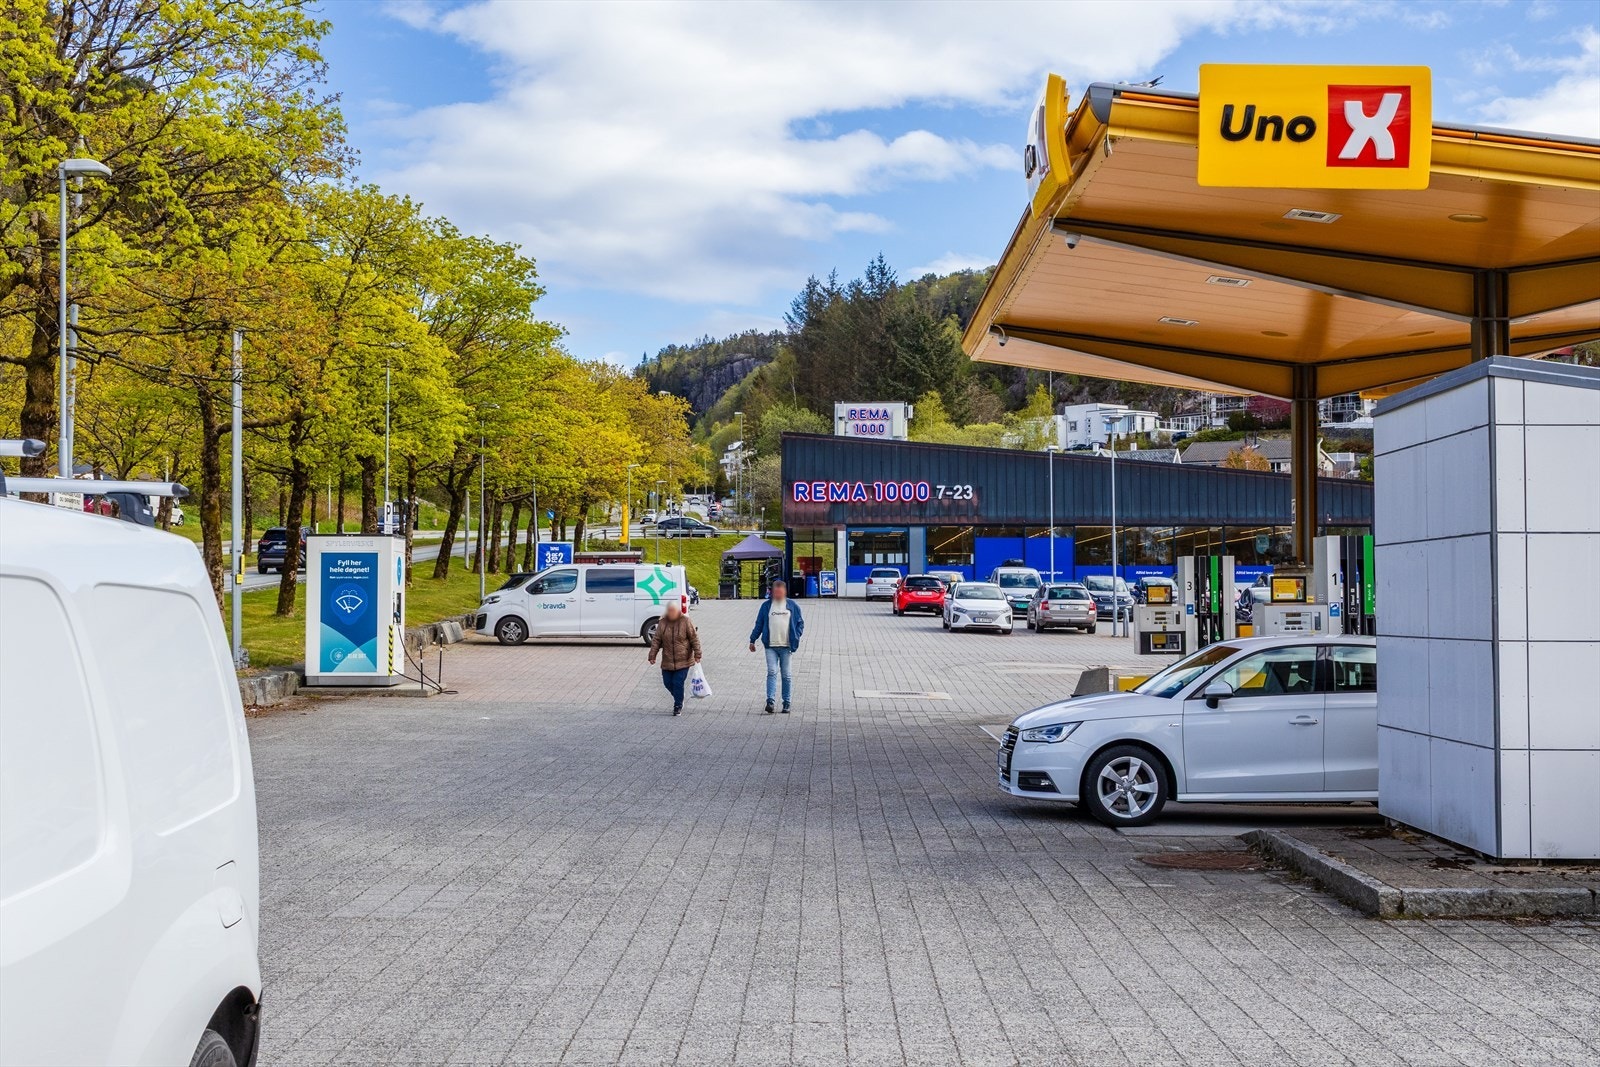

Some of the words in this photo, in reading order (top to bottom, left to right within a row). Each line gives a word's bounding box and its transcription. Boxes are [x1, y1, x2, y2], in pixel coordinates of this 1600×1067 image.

[1219, 103, 1317, 142] Uno
[1338, 93, 1402, 160] X
[848, 409, 890, 420] REMA
[854, 423, 885, 434] 1000
[794, 481, 867, 502] REMA
[873, 481, 930, 502] 1000
[936, 484, 974, 500] 7-23
[545, 552, 551, 563] 3
[558, 552, 564, 563] 2
[1331, 573, 1337, 586] 1
[1186, 581, 1193, 591] 3
[543, 602, 566, 610] bravida
